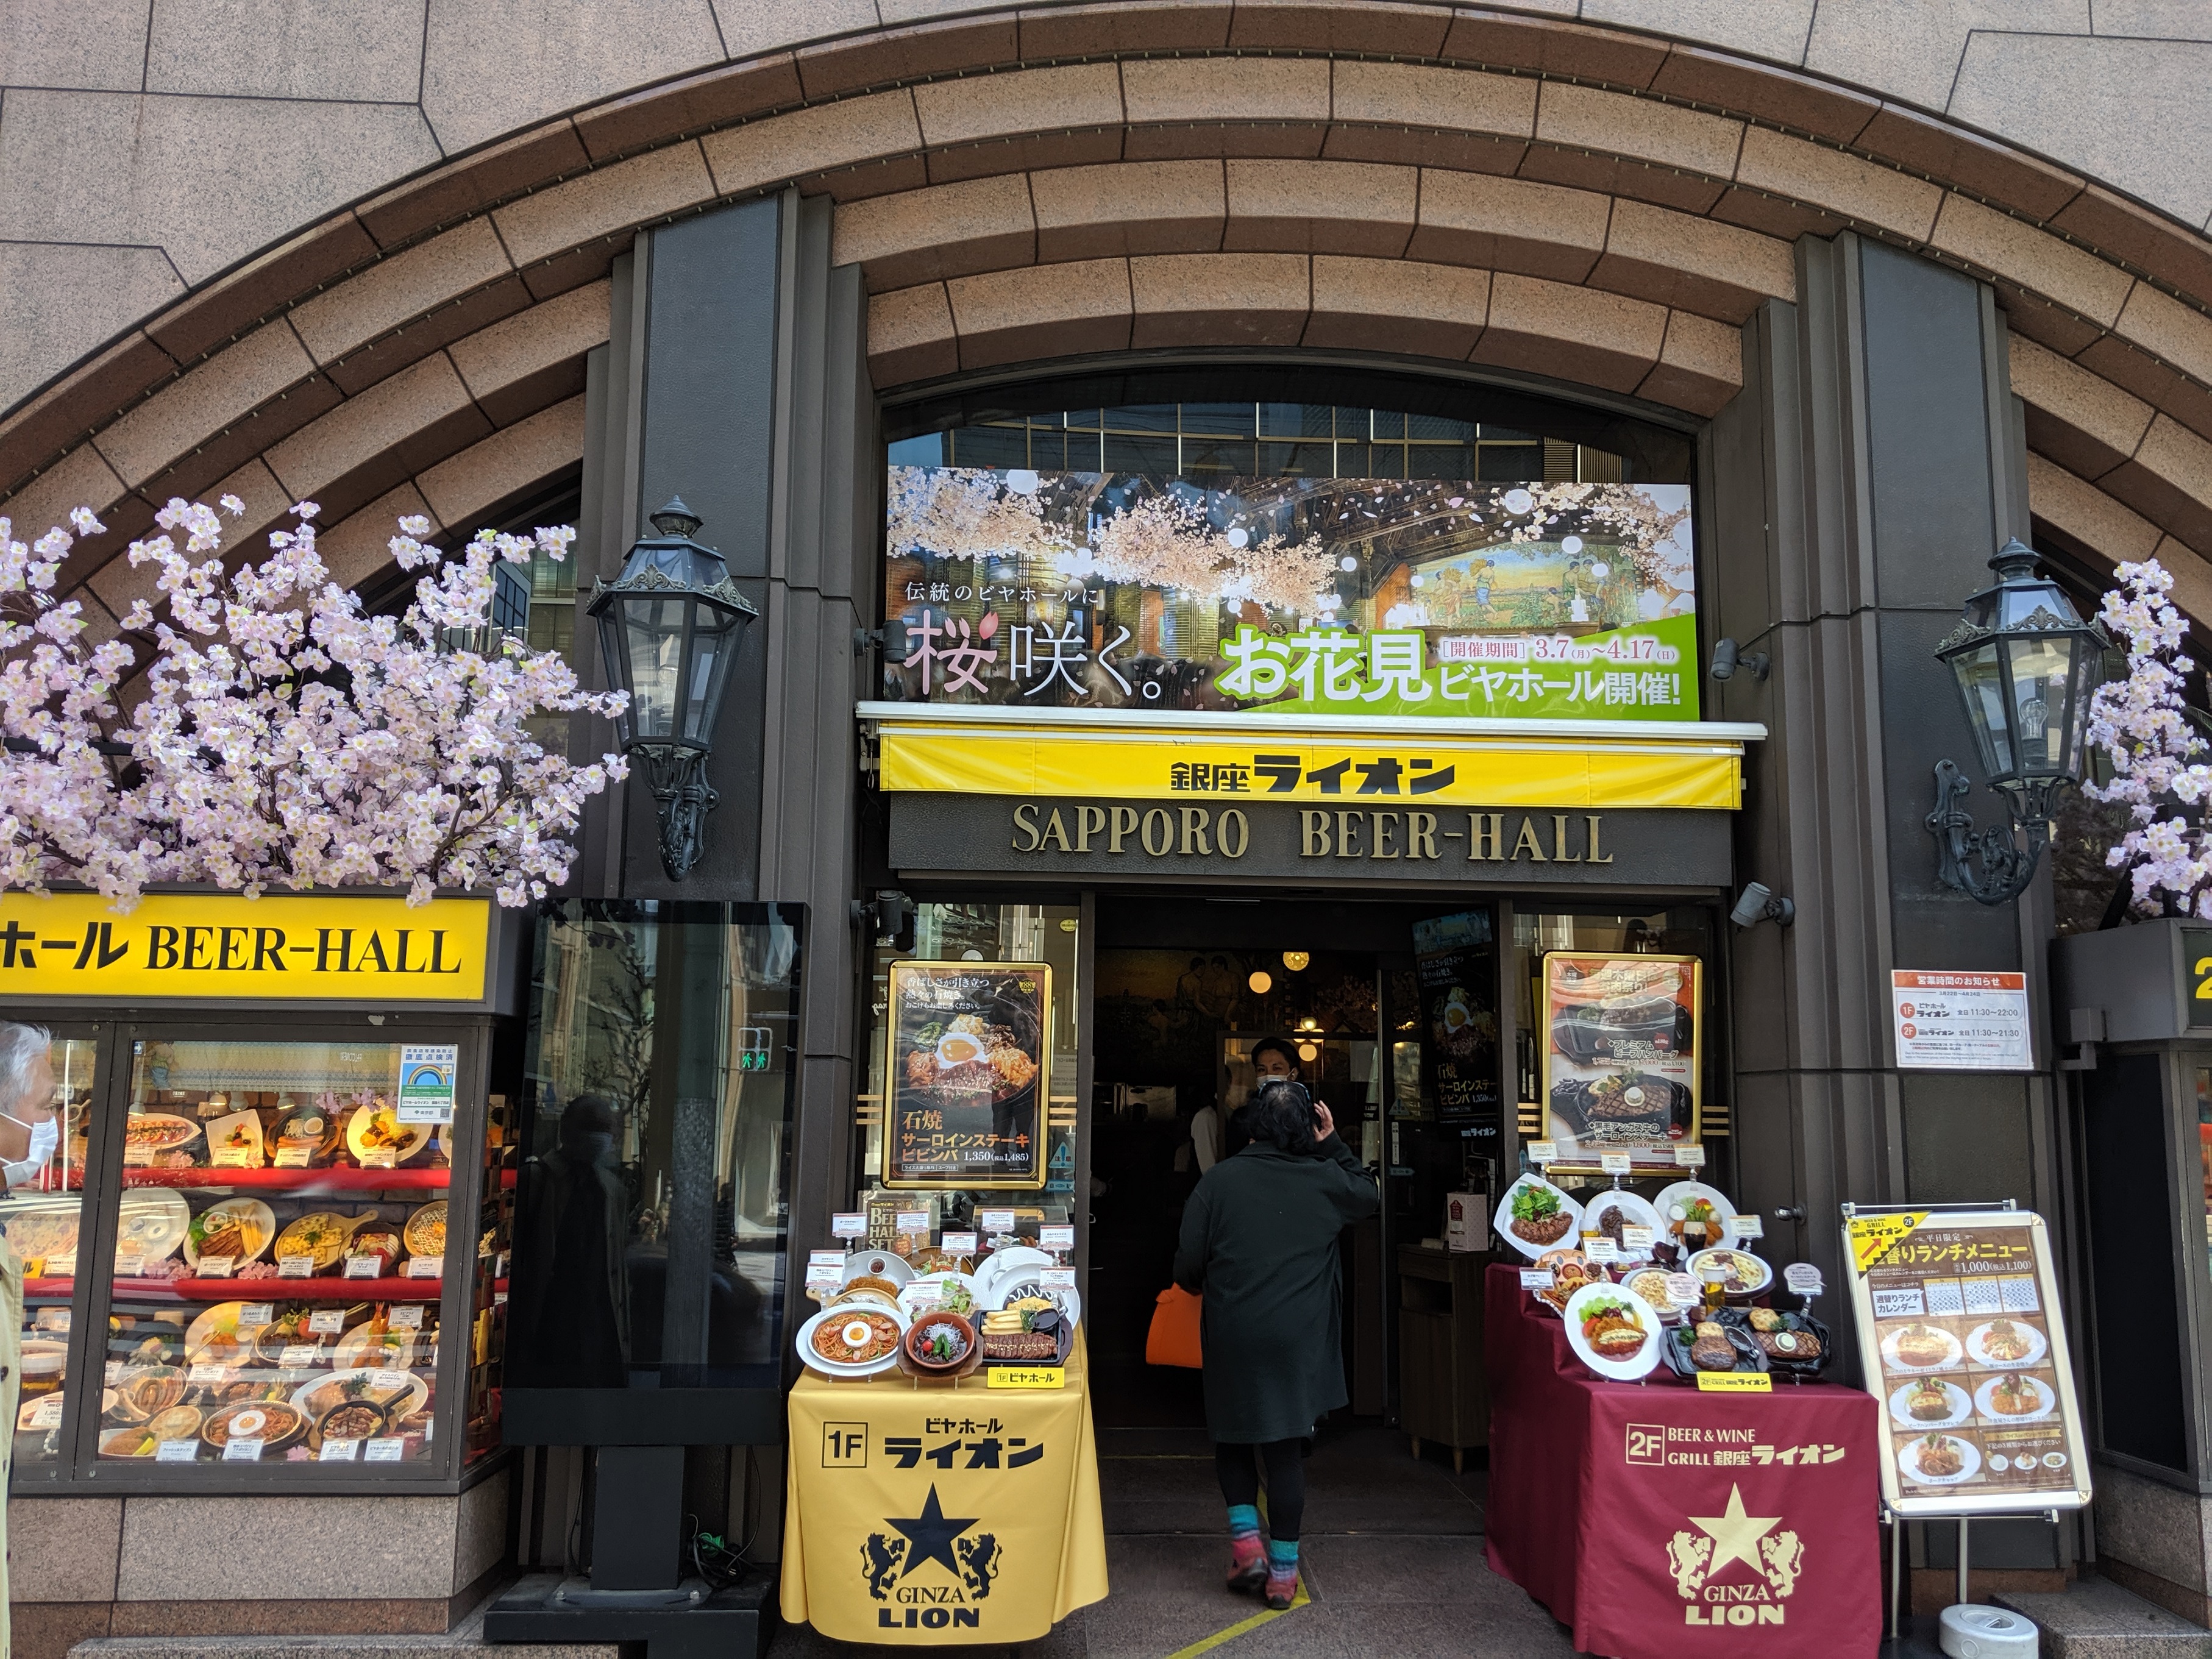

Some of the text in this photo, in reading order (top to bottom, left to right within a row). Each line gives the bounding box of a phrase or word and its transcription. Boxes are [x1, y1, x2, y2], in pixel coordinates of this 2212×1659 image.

[905, 580, 1098, 603] 伝統のビヤホールに
[903, 609, 1162, 700] 桜咲く。
[1220, 629, 1432, 702] お花見
[1171, 755, 1455, 795] 銀座ライオン
[1012, 804, 1613, 864] SAPPORO BEER-HALL
[143, 925, 462, 973] BEER-HALL
[906, 978, 990, 987] 香ばしさが引き立つ
[1917, 976, 2000, 986] 営業時間のお知らせ
[1614, 1040, 1654, 1050] プレミアム
[1614, 1049, 1679, 1059] ビーフハンバーグ
[1437, 1063, 1458, 1079] 石焼
[1440, 1093, 1470, 1106] ビビンバ
[902, 1109, 943, 1131] 石焼
[901, 1132, 1030, 1148] サーロインステーキ
[1595, 1132, 1667, 1142] サーロインステーキ
[902, 1148, 958, 1162] ビビンバ
[870, 1207, 897, 1226] BEE
[1852, 1227, 1902, 1238] 銀座ライオン
[1926, 1233, 1961, 1242] 平日限定
[869, 1238, 894, 1251] SET
[1877, 1243, 2028, 1265] 替りランチメニュー
[1876, 1293, 1919, 1304] 週替りランチ
[1878, 1304, 1916, 1313] カレンダー
[1009, 1373, 1055, 1384] ビヤホール
[925, 1418, 1003, 1434] ビヤホール
[828, 1430, 863, 1458] 1F
[1629, 1431, 1662, 1457] 2F
[1668, 1428, 1755, 1443] BEER & WINE
[884, 1438, 1044, 1469] ライオン
[1668, 1444, 1845, 1466] GRILL 銀座ライオン
[895, 1586, 966, 1604] GINZA
[1704, 1584, 1771, 1602] GINZA
[878, 1607, 980, 1628] LION
[1685, 1604, 1784, 1625] LION
